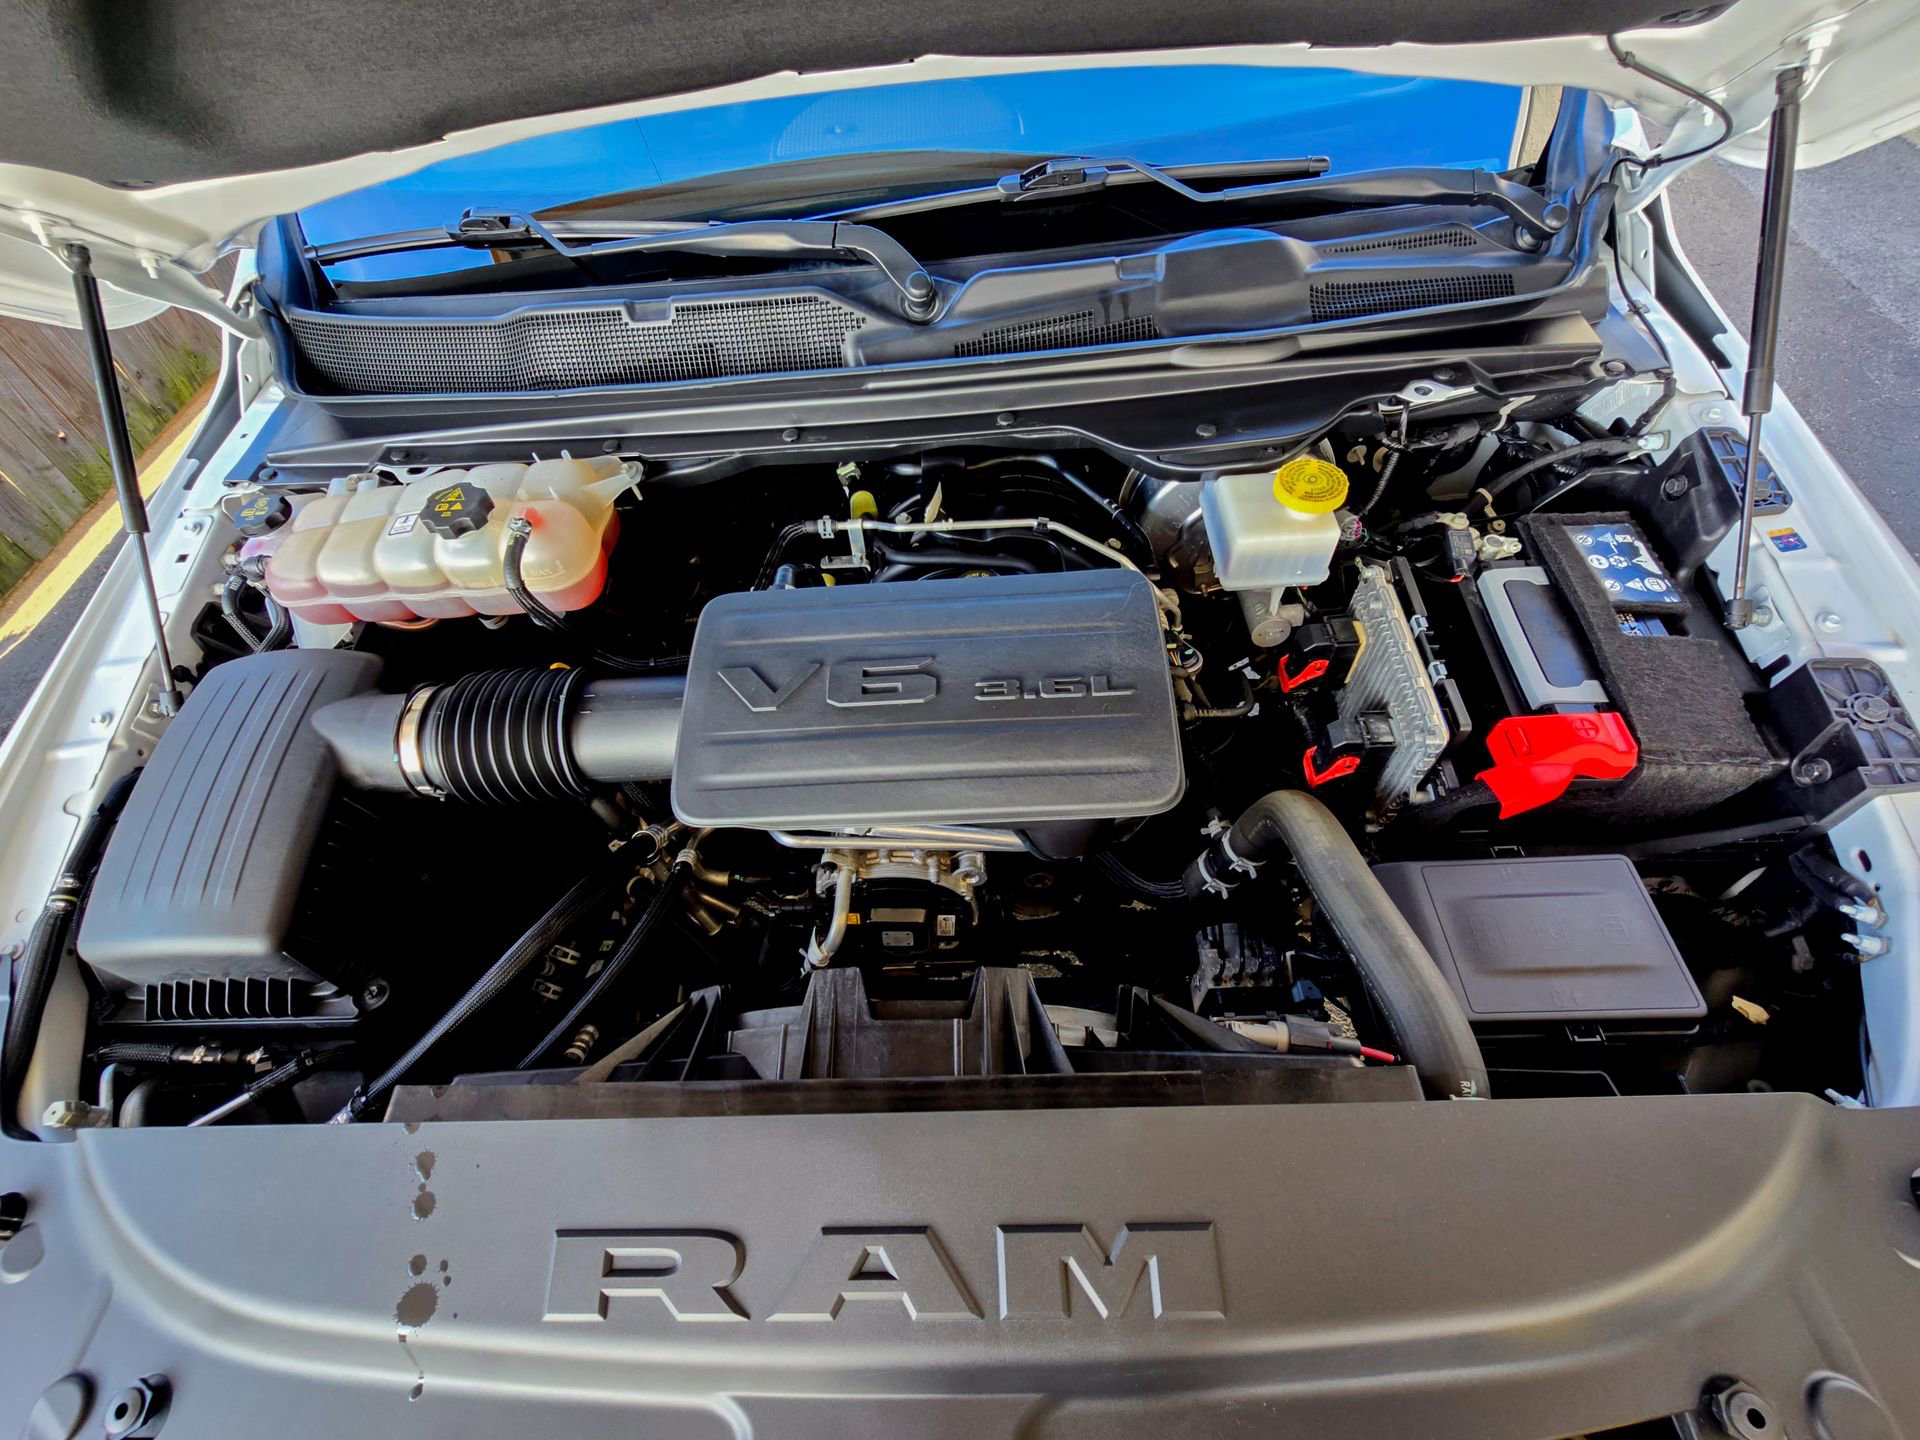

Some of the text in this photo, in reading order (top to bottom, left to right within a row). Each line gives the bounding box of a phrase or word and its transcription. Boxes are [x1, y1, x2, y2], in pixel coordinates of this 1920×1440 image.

[717, 657, 1137, 712] V6 3.6L
[541, 1222, 1227, 1321] RAM
